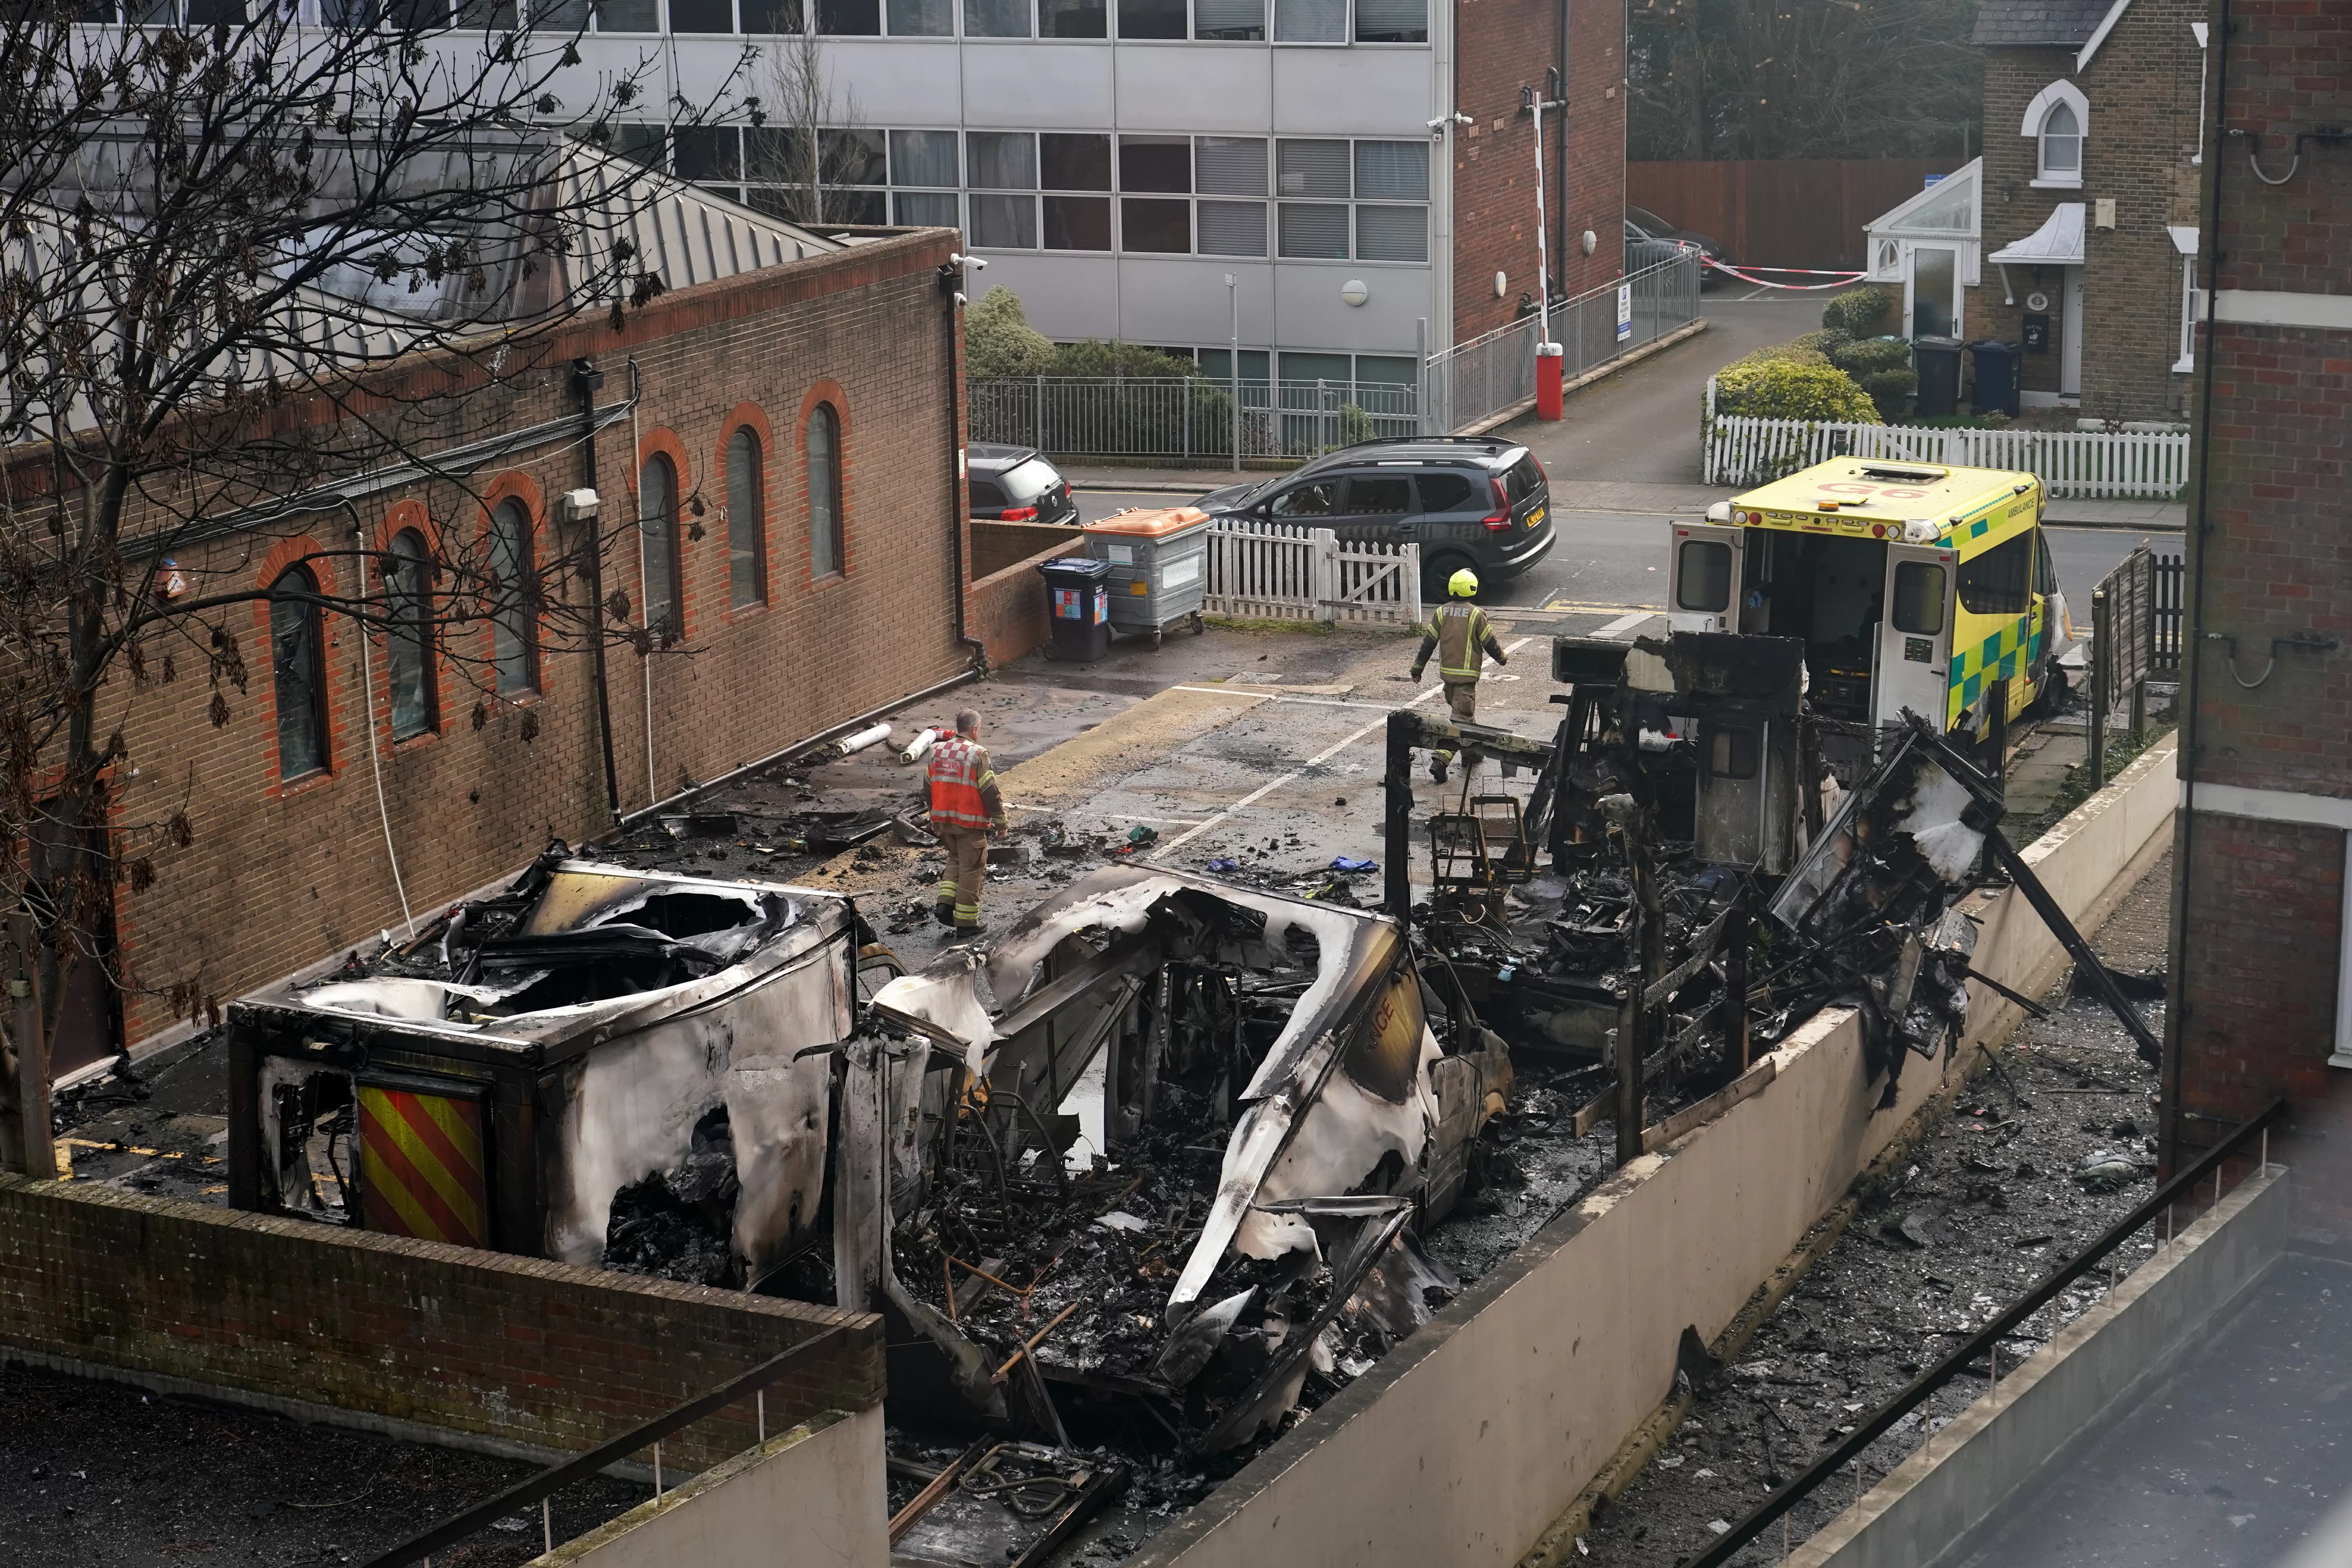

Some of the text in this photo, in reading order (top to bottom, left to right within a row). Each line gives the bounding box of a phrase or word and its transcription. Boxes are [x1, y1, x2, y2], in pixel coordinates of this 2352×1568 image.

[1958, 431, 1964, 439] 2
[2007, 497, 2035, 519] AMBULANCE
[1443, 607, 1470, 618] FIRE
